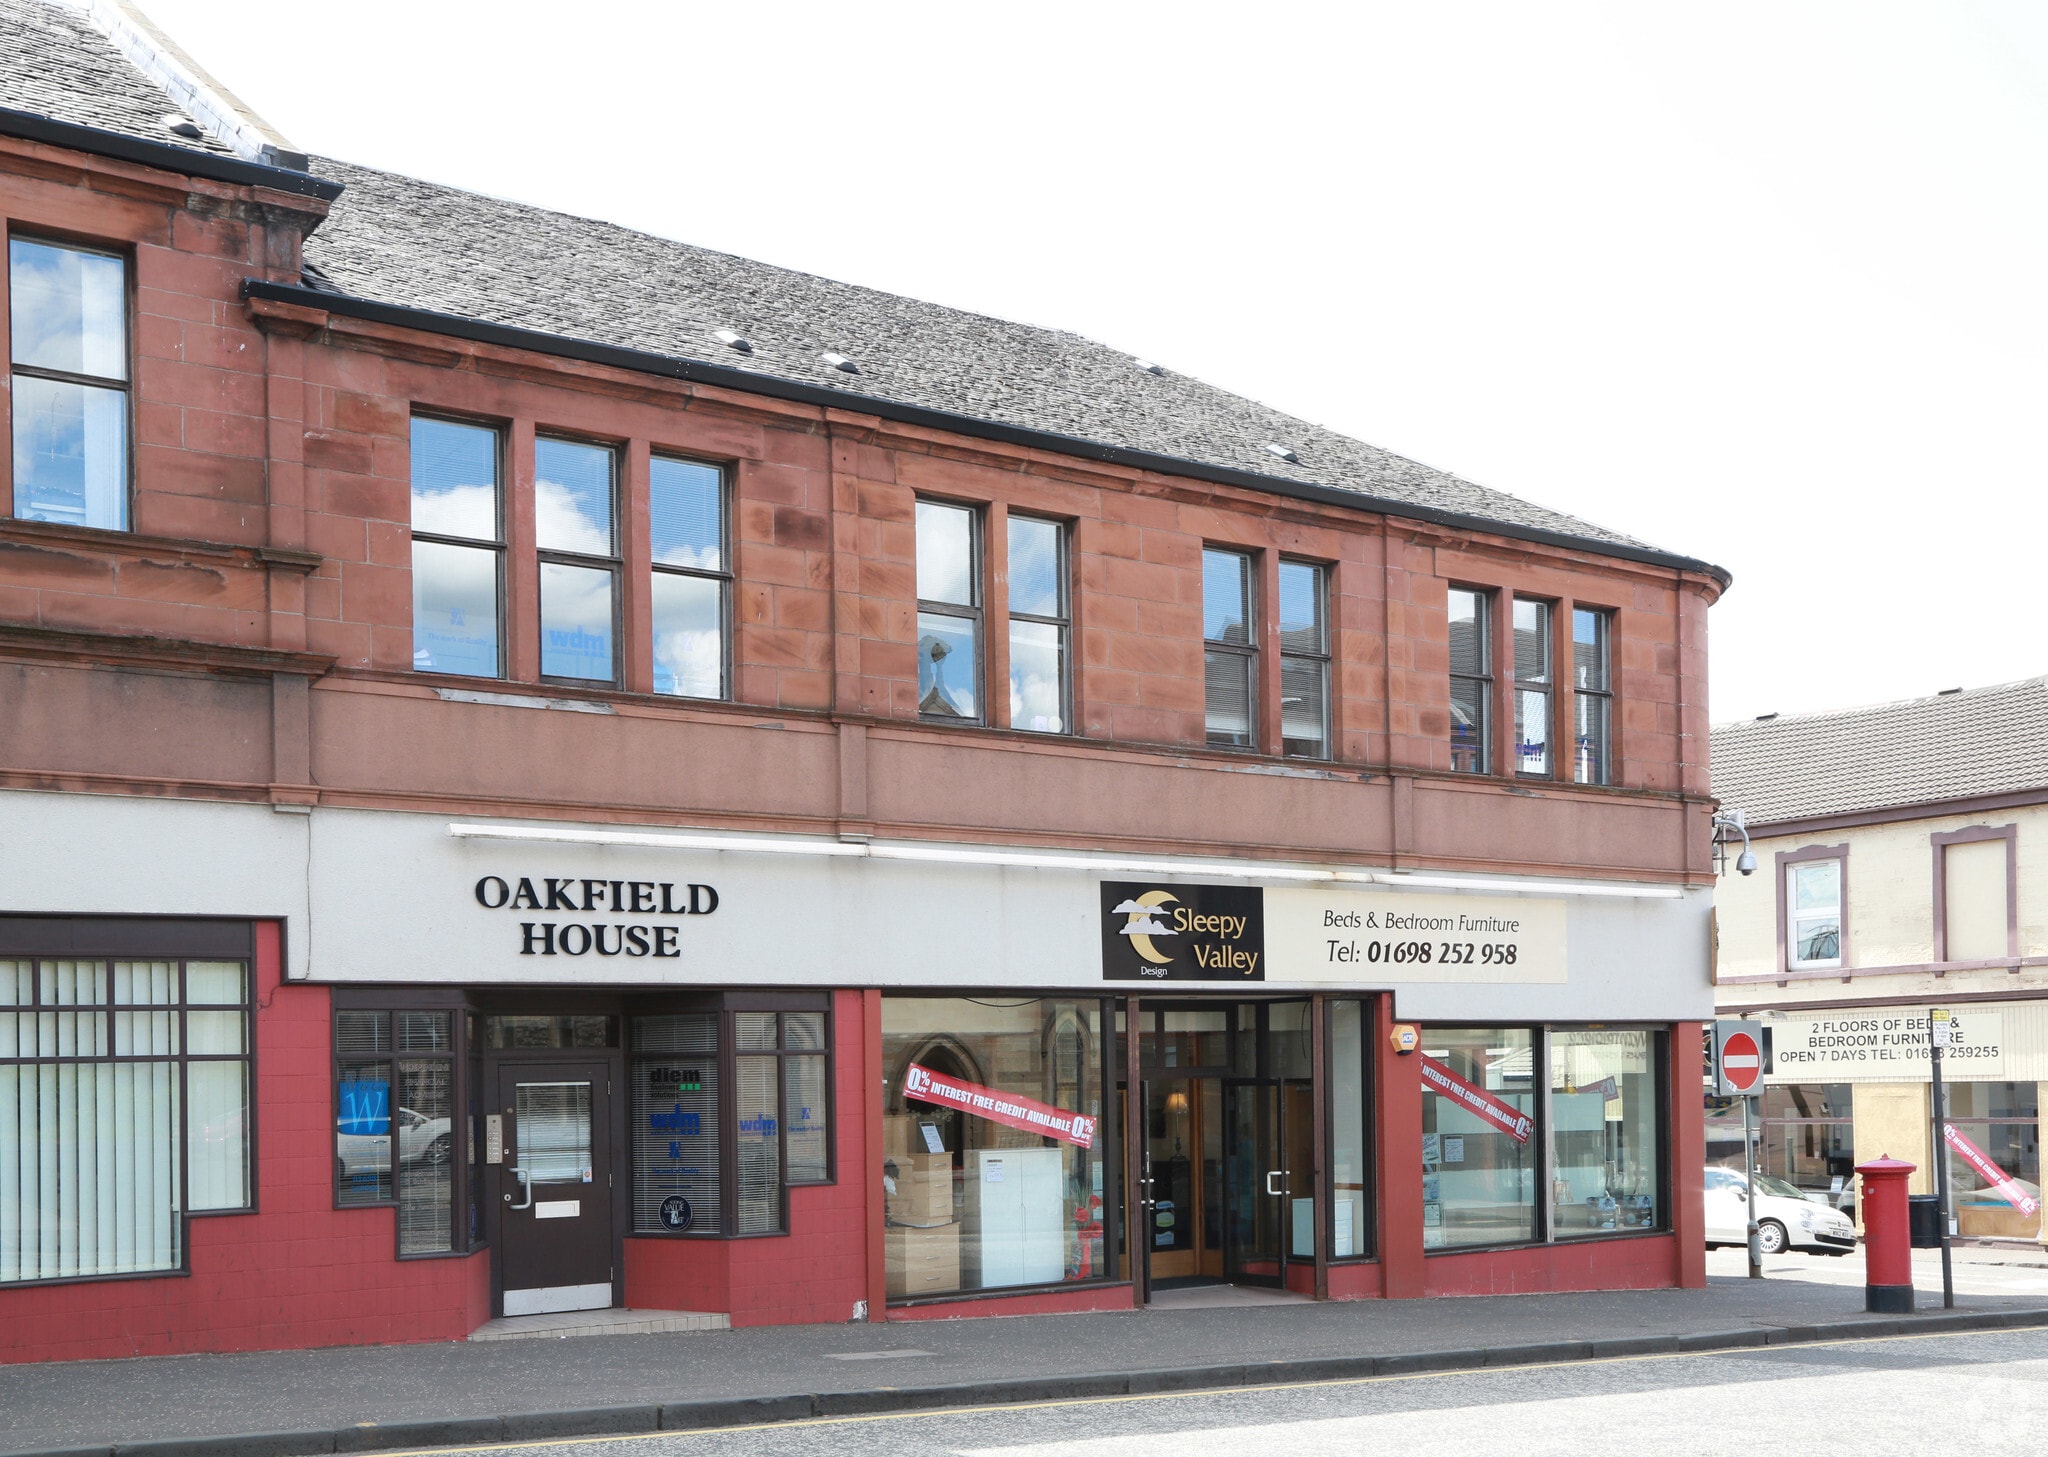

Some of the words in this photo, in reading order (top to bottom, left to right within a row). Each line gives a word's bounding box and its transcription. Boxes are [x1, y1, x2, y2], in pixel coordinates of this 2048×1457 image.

[549, 624, 605, 651] wdm
[475, 876, 719, 915] OAKFIELD
[1173, 907, 1247, 939] Sleepy
[1323, 909, 1361, 929] Beds
[1366, 911, 1379, 928] &
[1385, 912, 1454, 931] Bedroom
[1458, 914, 1520, 933] Furniture
[520, 923, 681, 958] HOUSE
[1327, 940, 1360, 963] Tel:
[1367, 940, 1432, 964] 01698
[1438, 942, 1475, 964] 252
[1481, 943, 1518, 965] 958
[1140, 966, 1168, 978] Design
[1193, 944, 1259, 975] Valley
[1812, 1023, 1819, 1033] 2
[1823, 1020, 1879, 1033] FLOORS
[1883, 1019, 1901, 1030] OF
[1950, 1016, 1960, 1029] &
[1809, 1035, 1878, 1048] BEDROOM
[1883, 1031, 1964, 1046] FURNITRE
[1780, 1051, 1816, 1063] OPEN
[1820, 1050, 1826, 1061] 7
[1831, 1049, 1867, 1061] DAYS
[1871, 1048, 1901, 1060] TEL:
[1949, 1046, 1999, 1058] 259255
[650, 1067, 700, 1082] diem
[907, 1067, 931, 1091] 0%
[930, 1081, 973, 1104] INTEREST
[972, 1094, 995, 1110] FREE
[994, 1100, 1028, 1119] CREDIT
[1026, 1110, 1072, 1133] AVAILABLE
[1071, 1116, 1094, 1138] 0%
[1422, 1065, 1452, 1091] INTEREST
[1450, 1081, 1465, 1097] FREE
[1464, 1090, 1487, 1110] CREDIT
[1485, 1103, 1518, 1128] AVAILABLE
[346, 1091, 383, 1133] W
[650, 1103, 700, 1128] wdm
[739, 1113, 777, 1131] wdm
[1972, 1150, 1986, 1168] FREE
[1982, 1163, 2002, 1182] CREDIT
